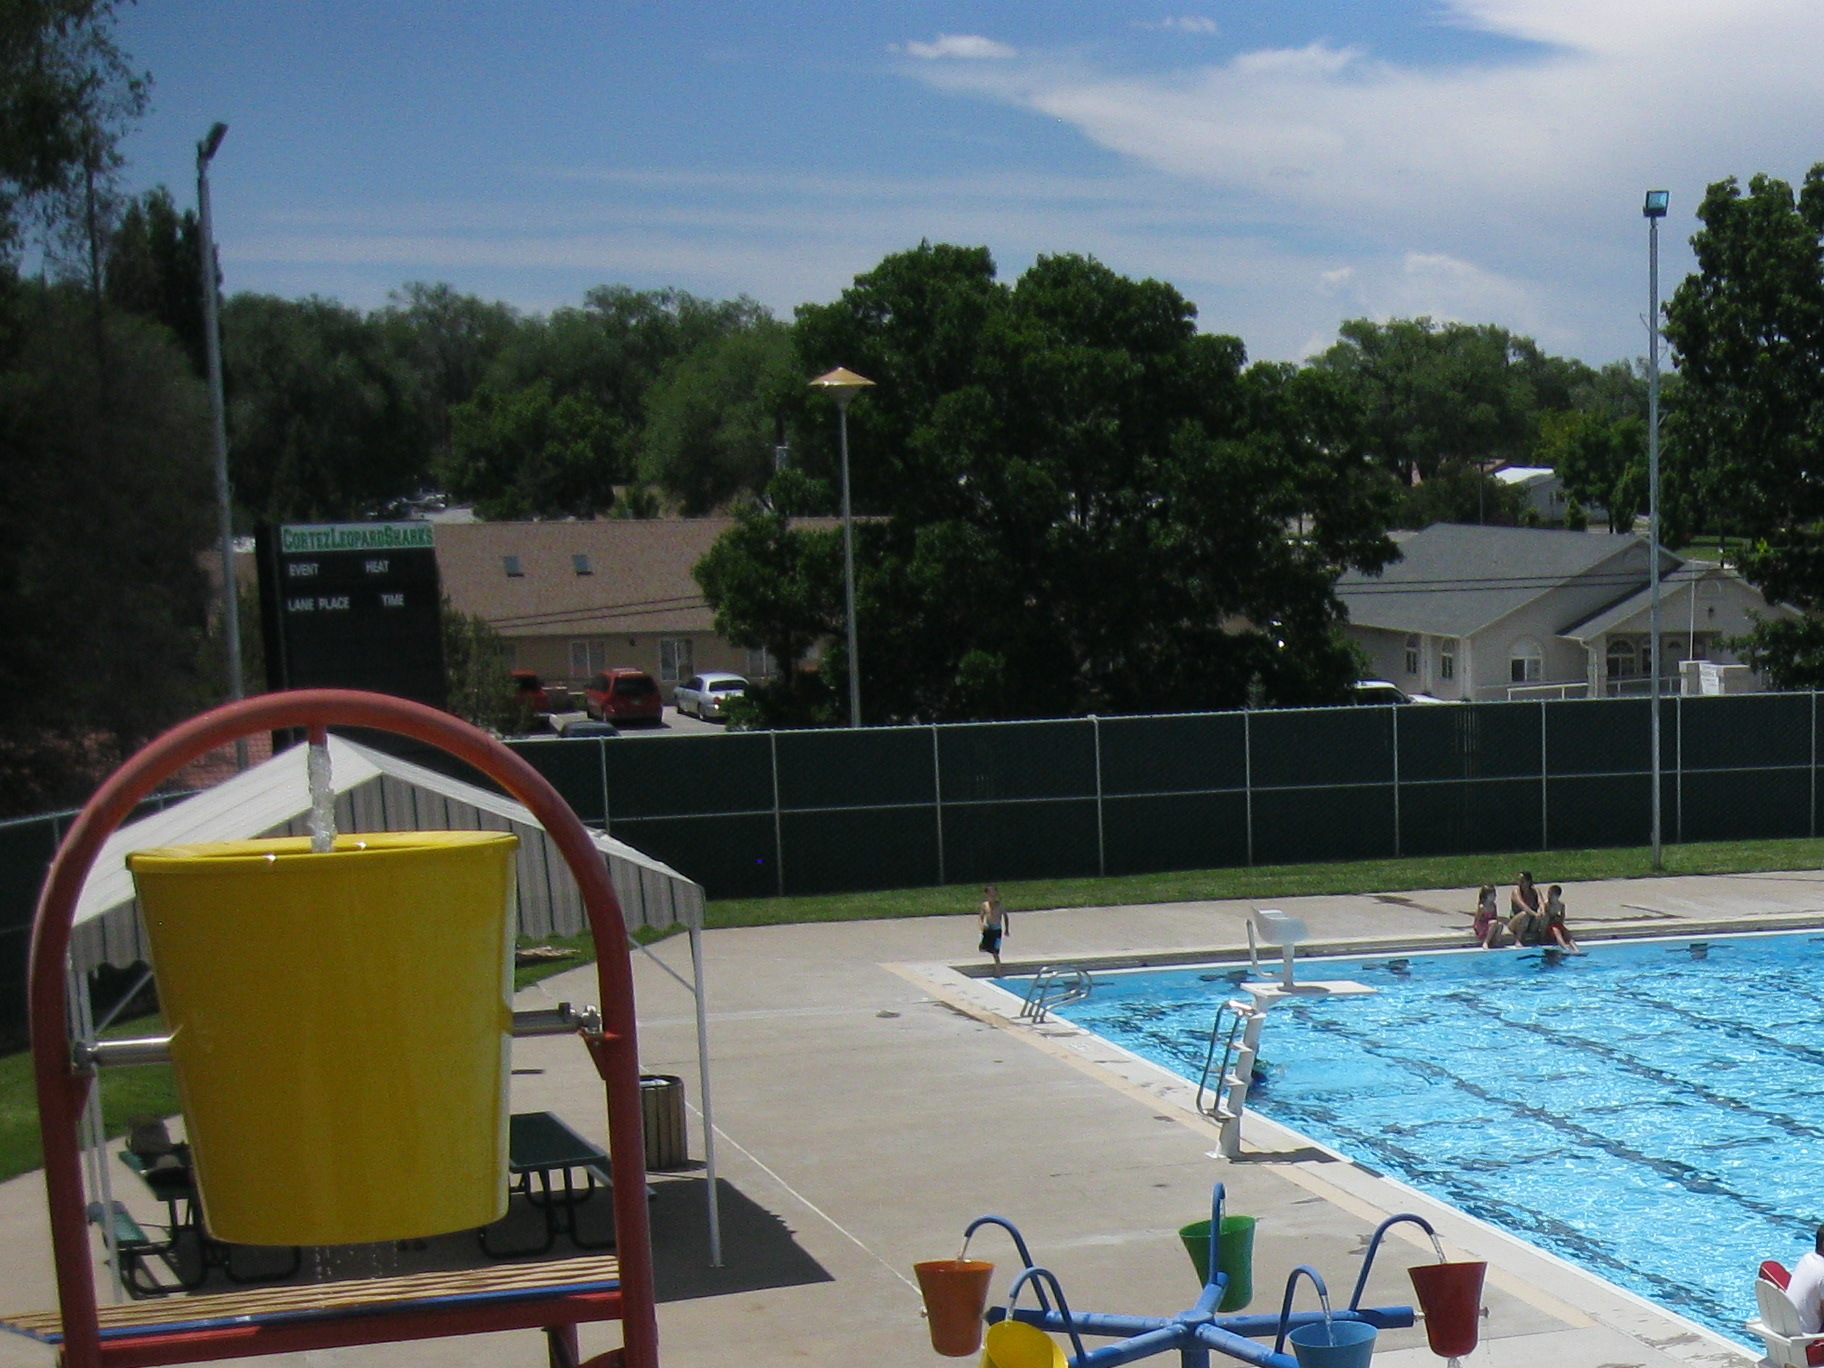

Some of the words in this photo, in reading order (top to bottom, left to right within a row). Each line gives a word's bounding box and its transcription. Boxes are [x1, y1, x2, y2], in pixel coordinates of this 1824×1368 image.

[289, 563, 319, 576] EVENT
[365, 560, 389, 573] HEAT
[288, 598, 314, 611] LANE
[318, 597, 349, 610] PLACE
[381, 593, 404, 606] TIME
